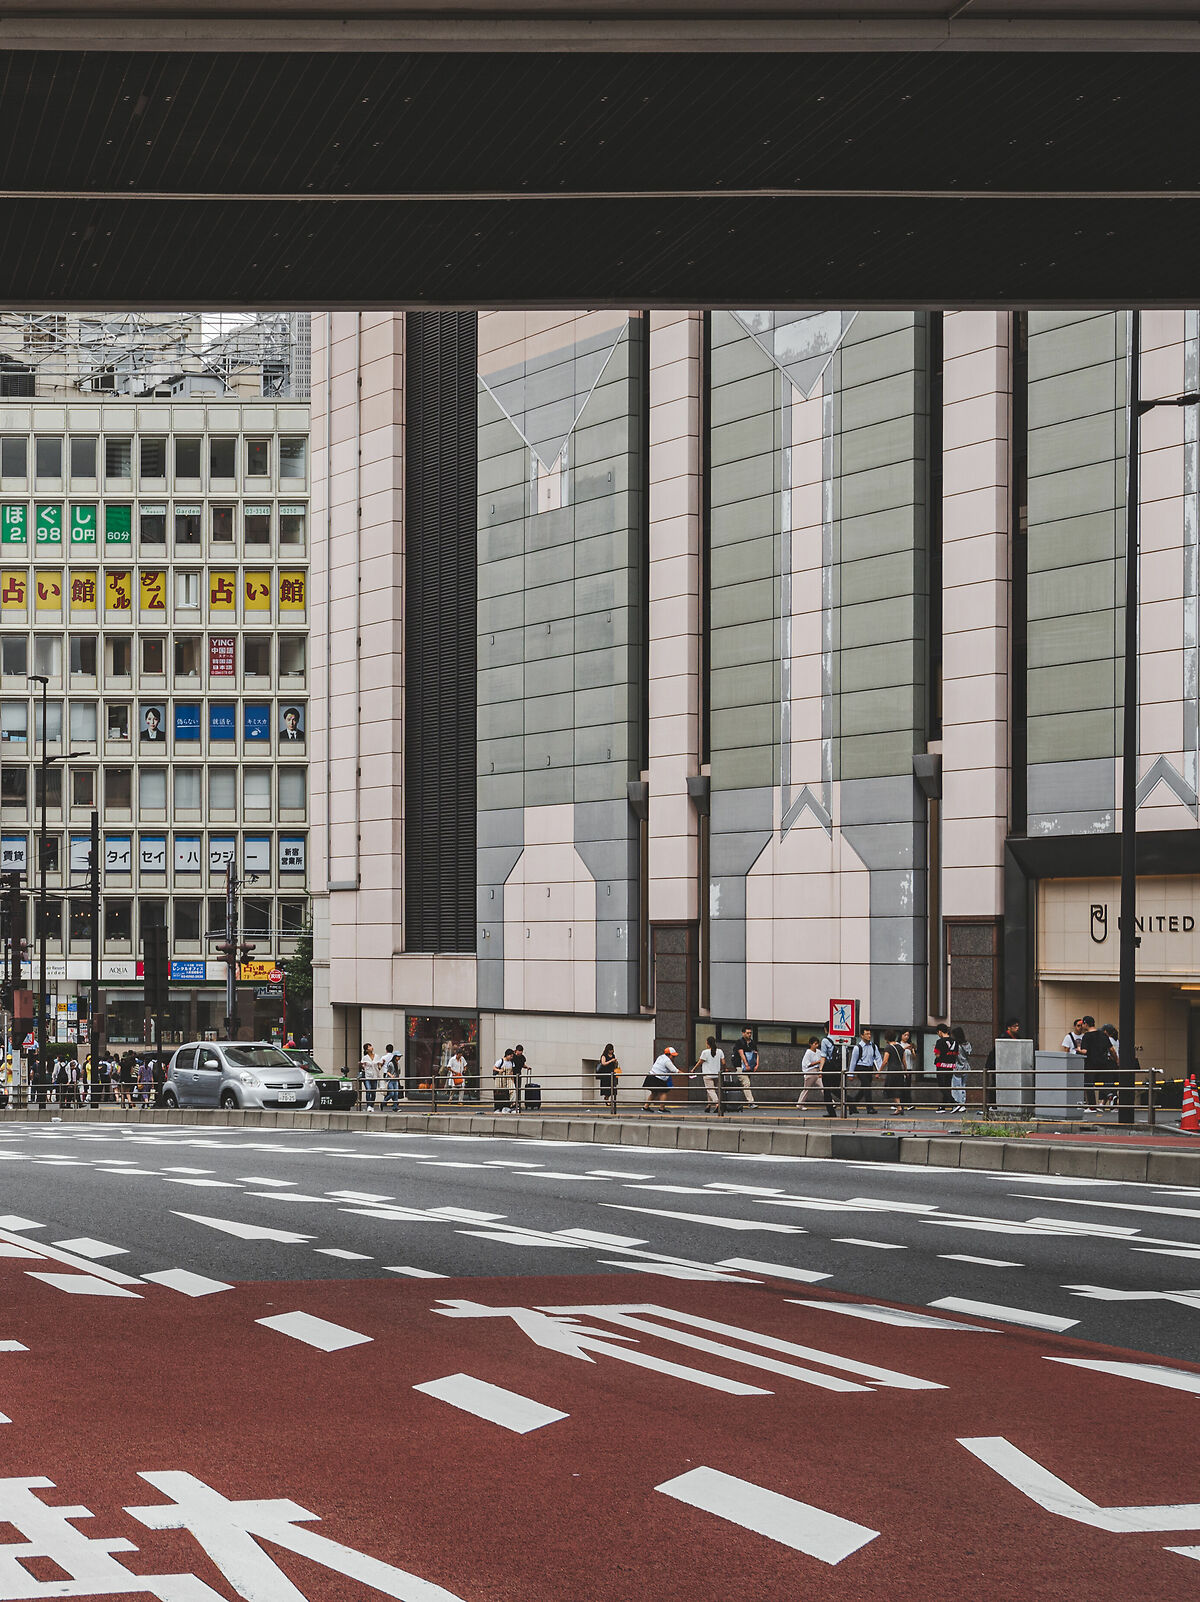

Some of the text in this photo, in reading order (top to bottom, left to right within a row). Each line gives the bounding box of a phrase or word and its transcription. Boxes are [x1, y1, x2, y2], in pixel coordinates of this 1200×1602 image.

[6, 506, 90, 524] ほぐし
[107, 531, 130, 541] 60分
[2, 577, 95, 604] 占い館
[210, 577, 304, 604] 占い館
[3, 850, 24, 862] 賃貸
[284, 848, 300, 856] 新宿
[281, 857, 303, 866] 営業所
[1118, 916, 1195, 933] NITED
[108, 966, 129, 975] AQUA
